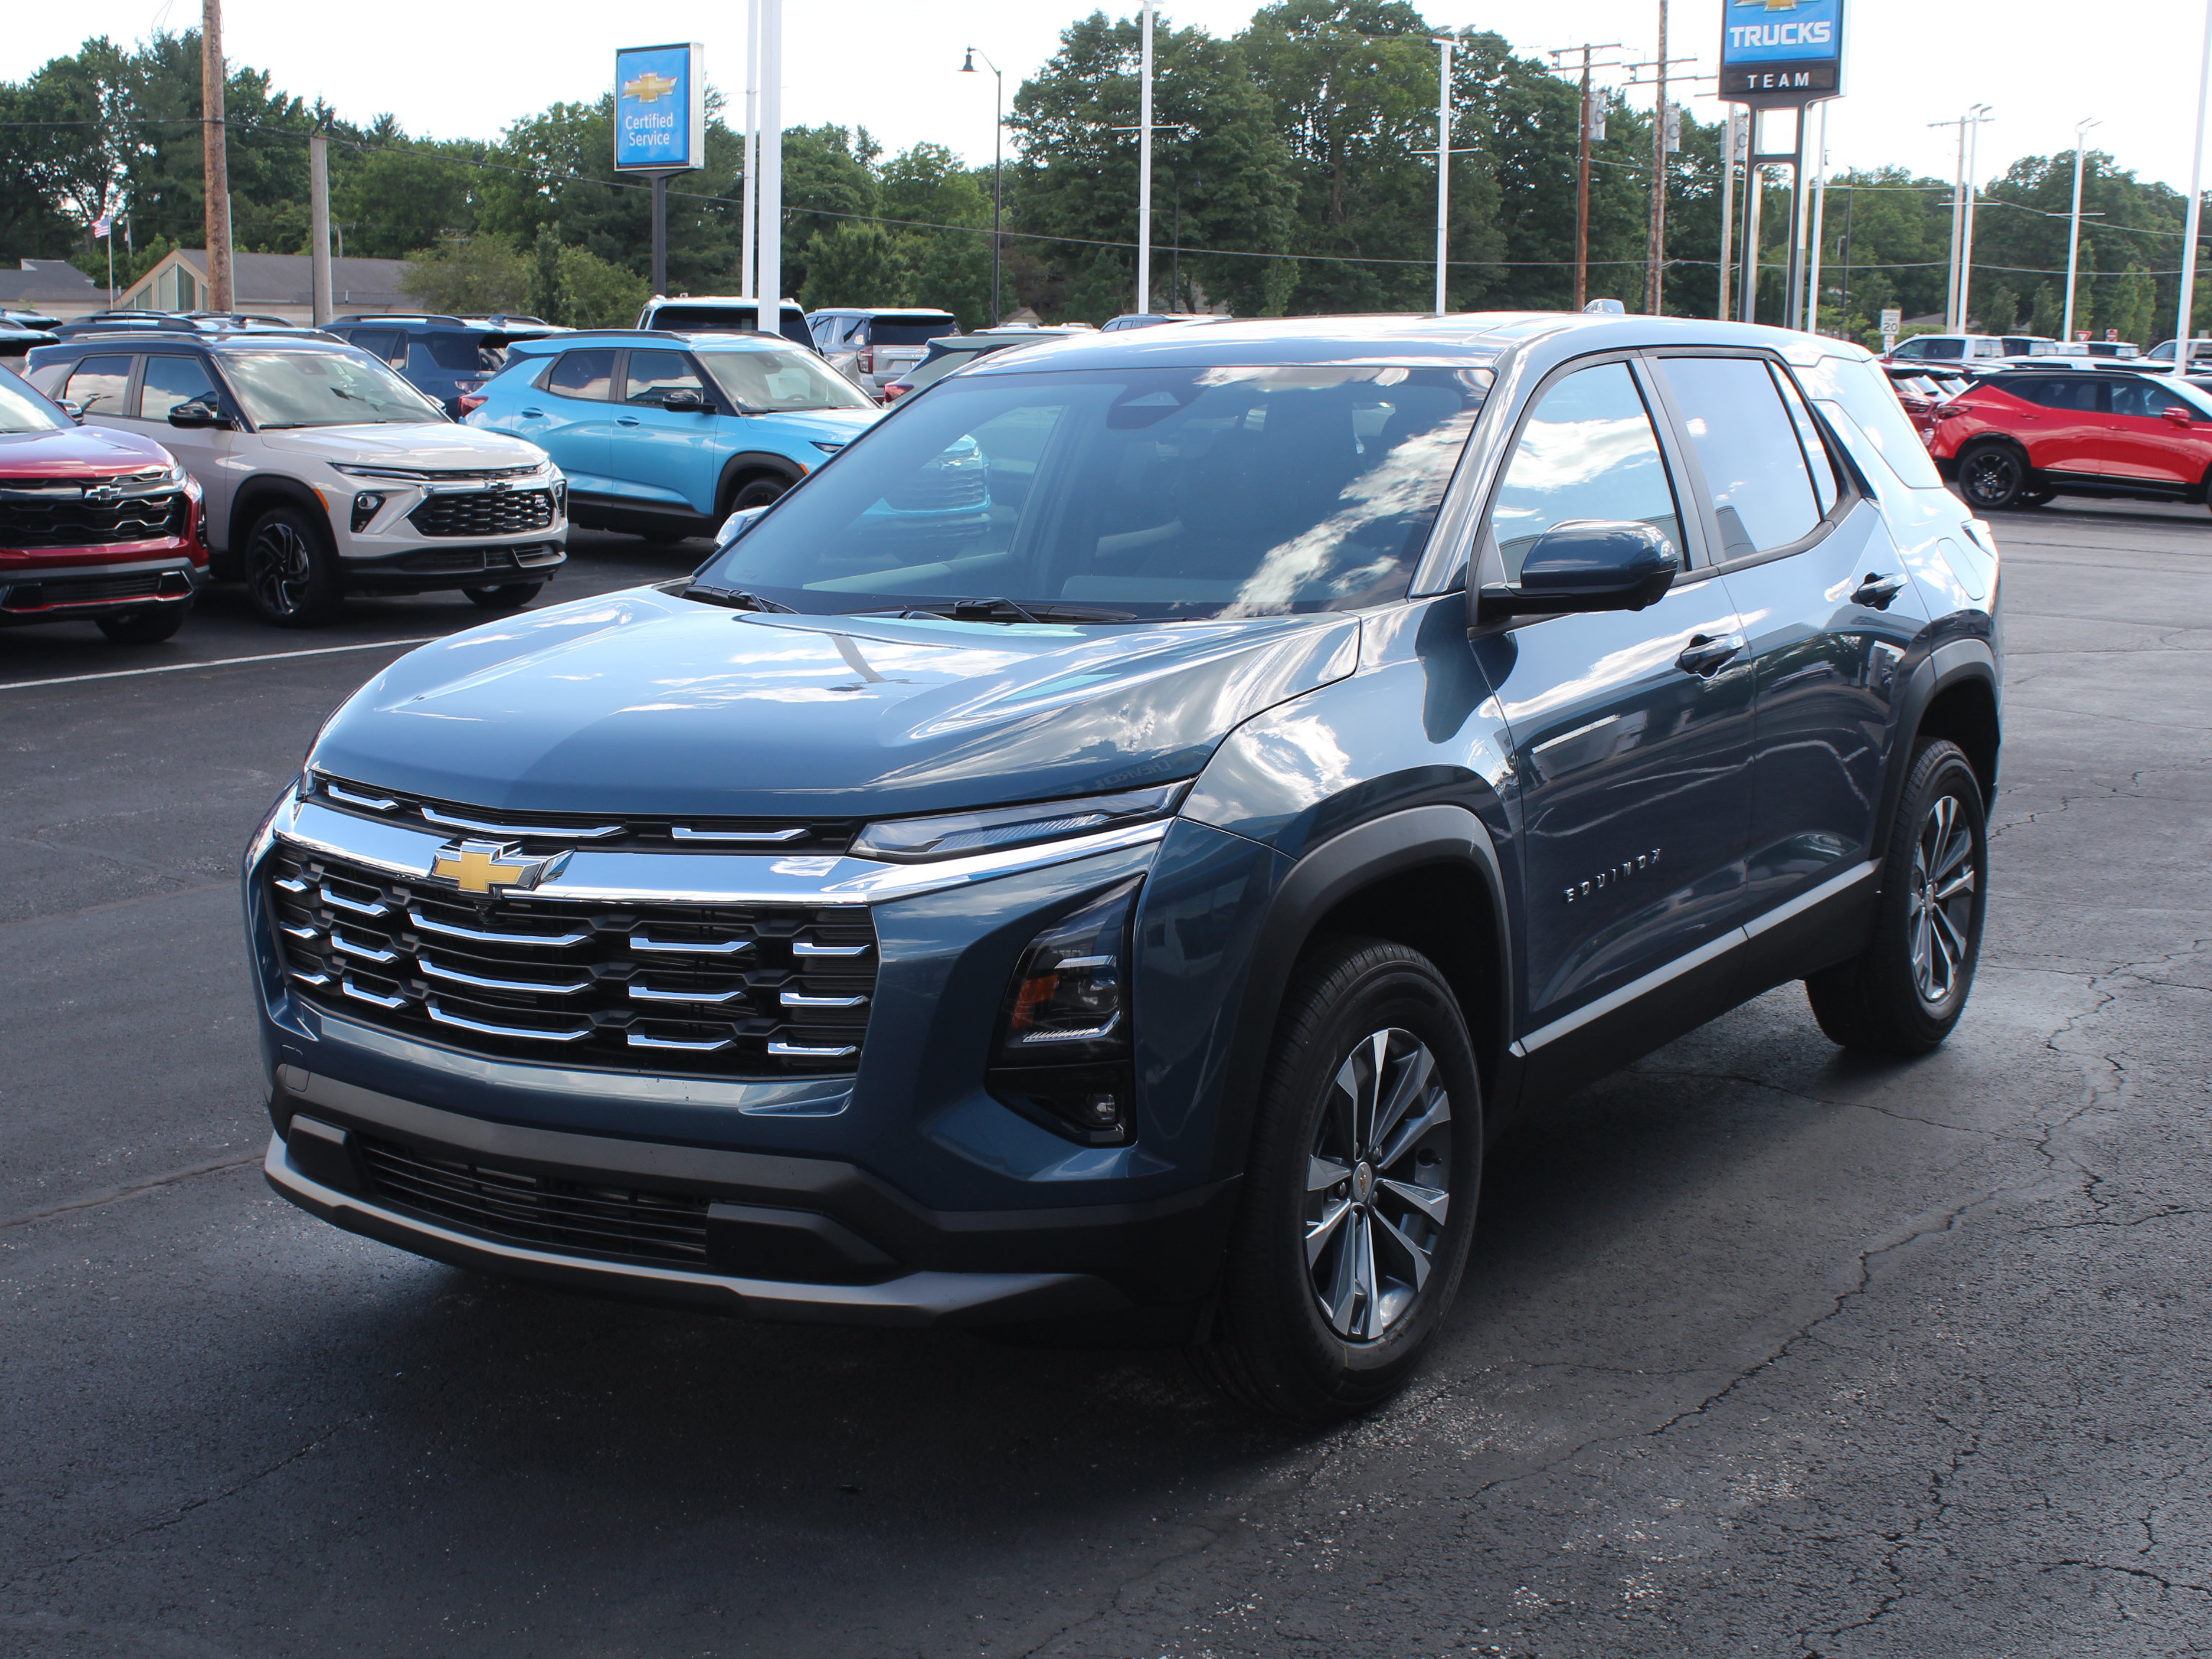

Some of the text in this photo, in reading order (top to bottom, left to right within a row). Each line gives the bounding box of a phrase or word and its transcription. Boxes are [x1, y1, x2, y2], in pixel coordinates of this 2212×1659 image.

[1730, 21, 1831, 48] TRUCKS
[1747, 71, 1809, 89] TEAM
[625, 112, 673, 130] Certified
[629, 130, 670, 146] Service
[1883, 322, 1898, 331] 20
[1563, 848, 1660, 903] EQUINOX
